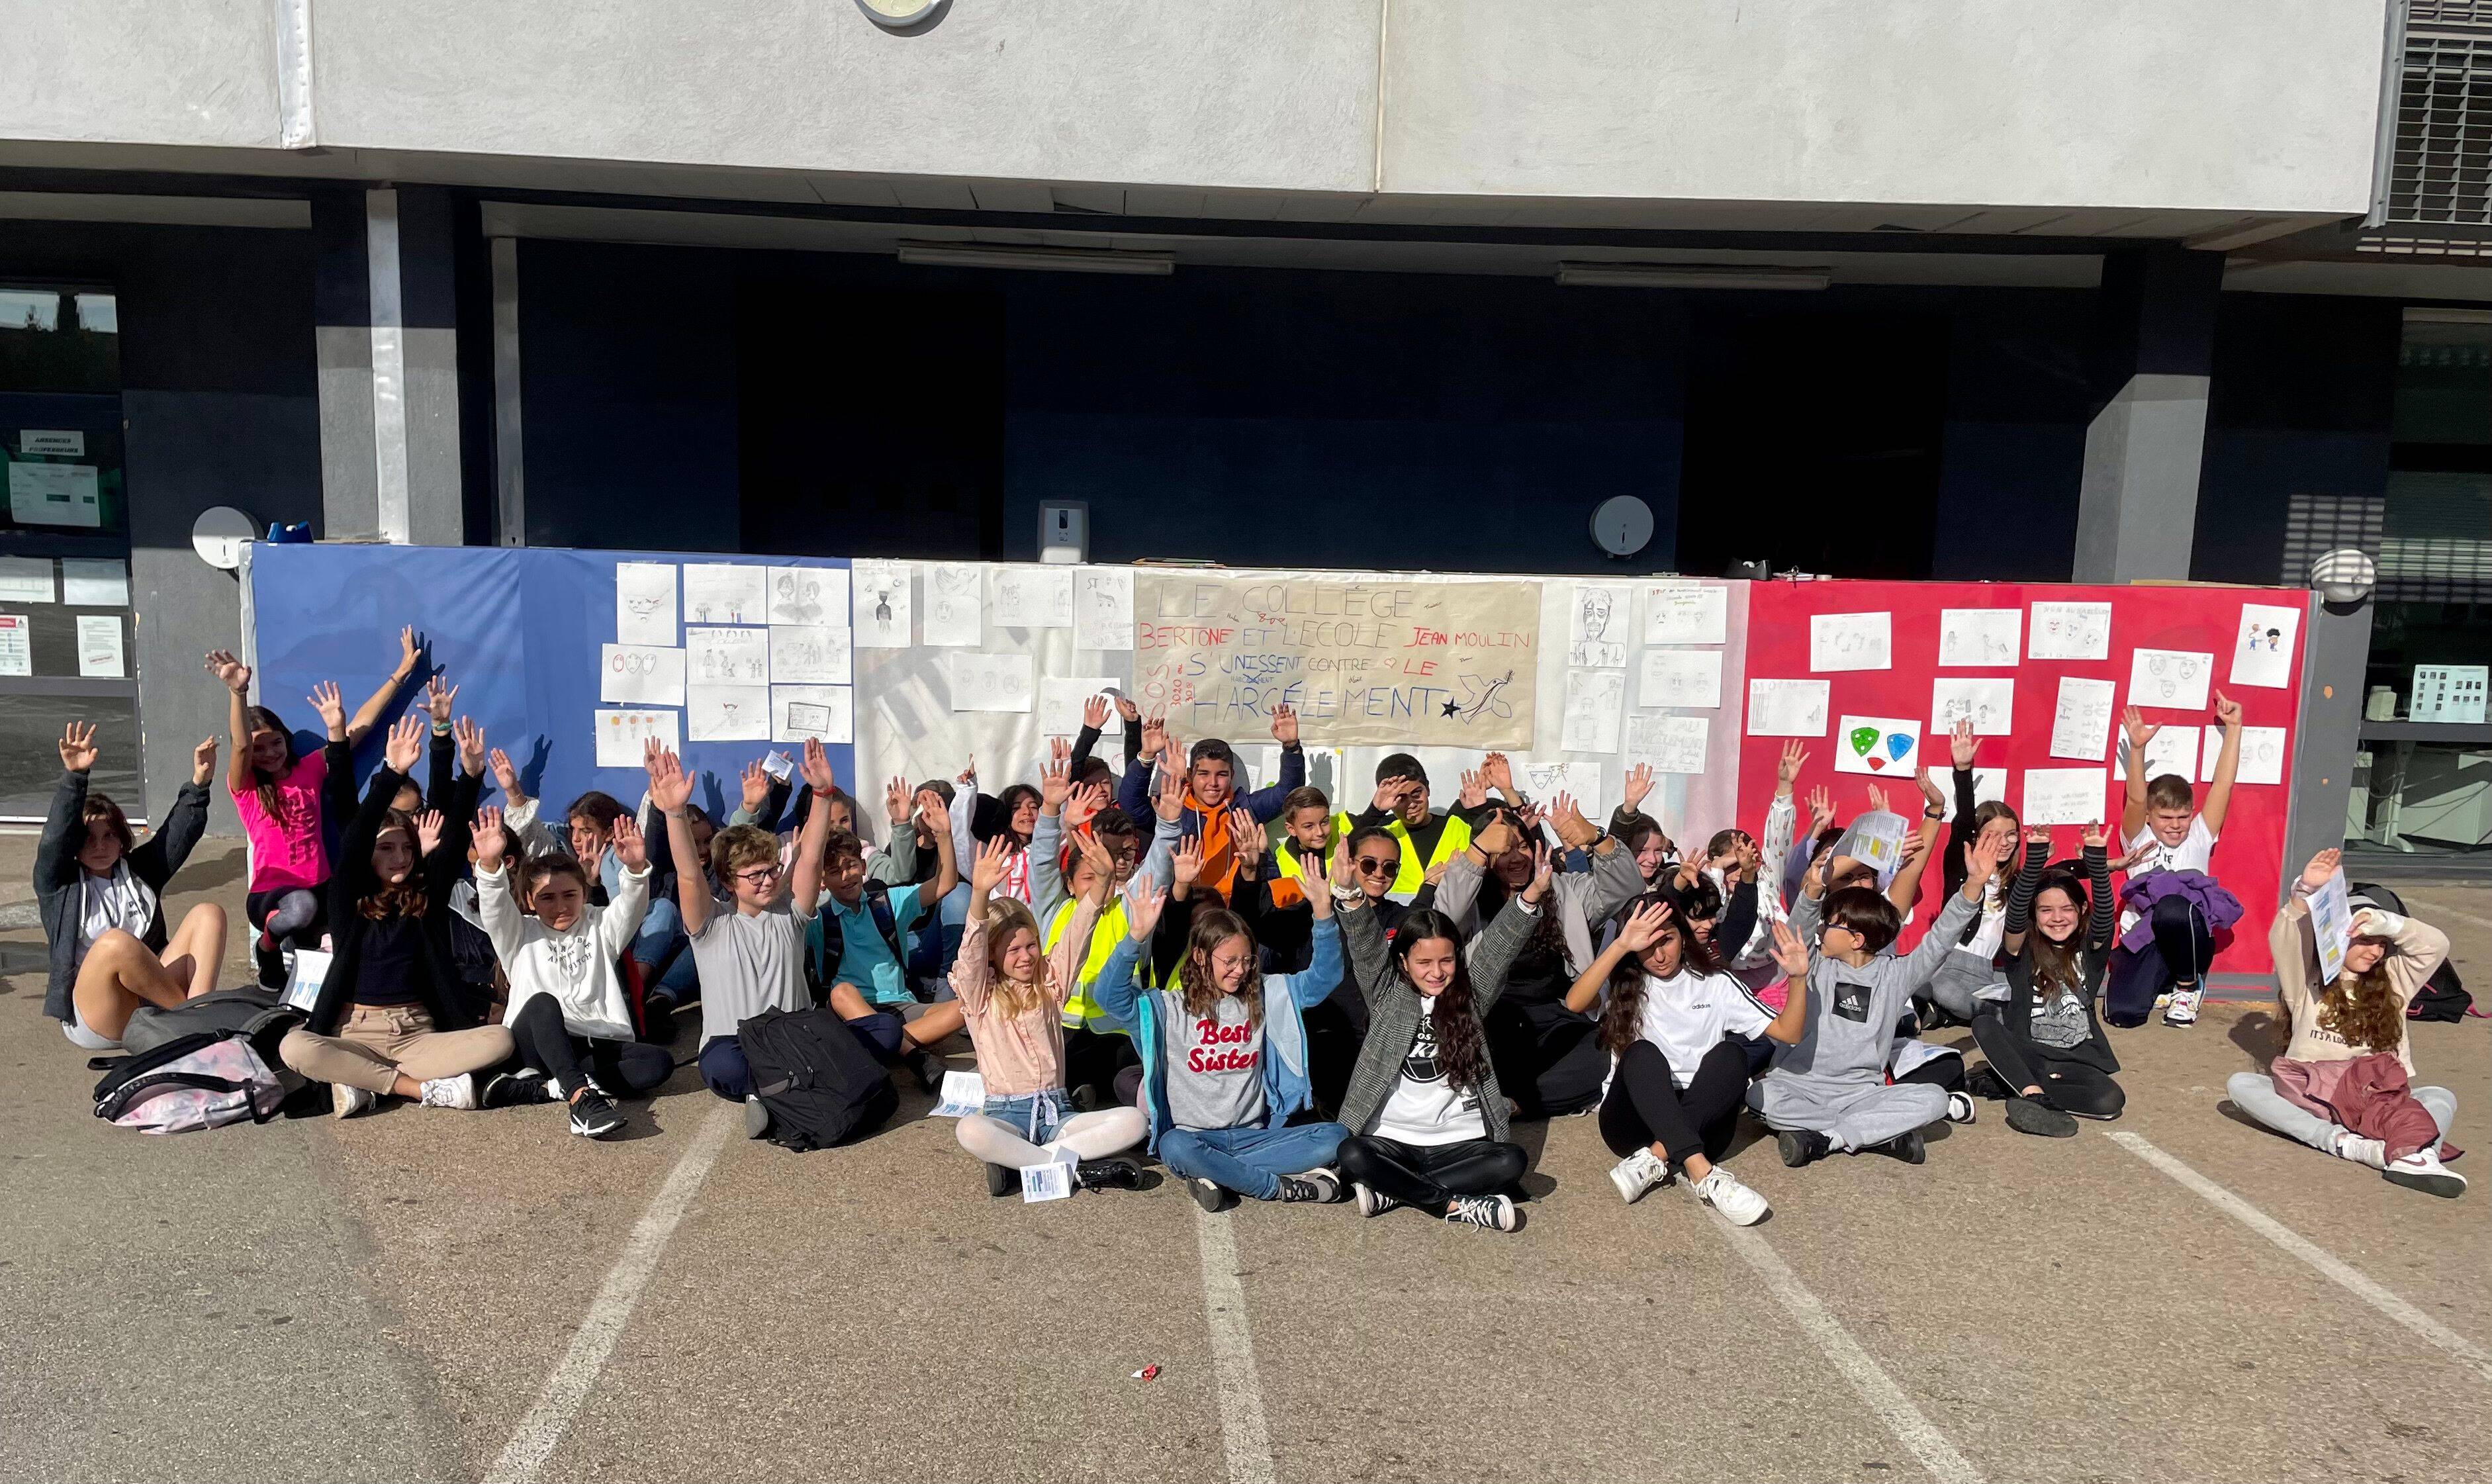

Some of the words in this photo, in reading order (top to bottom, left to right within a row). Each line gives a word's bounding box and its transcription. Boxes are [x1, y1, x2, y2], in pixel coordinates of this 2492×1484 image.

[1158, 584, 1223, 618] LE
[1139, 622, 1234, 649] BERTONE
[1243, 628, 1277, 646] ET
[1403, 626, 1448, 647] JEAN
[1455, 631, 1530, 648] MOULIN
[1308, 657, 1371, 671] CONTRE
[1403, 657, 1439, 676] LE
[1142, 663, 1170, 719] SOS
[1170, 678, 1182, 709] 3020
[1839, 1002, 1862, 1013] adidas
[1195, 1018, 1253, 1046] Best
